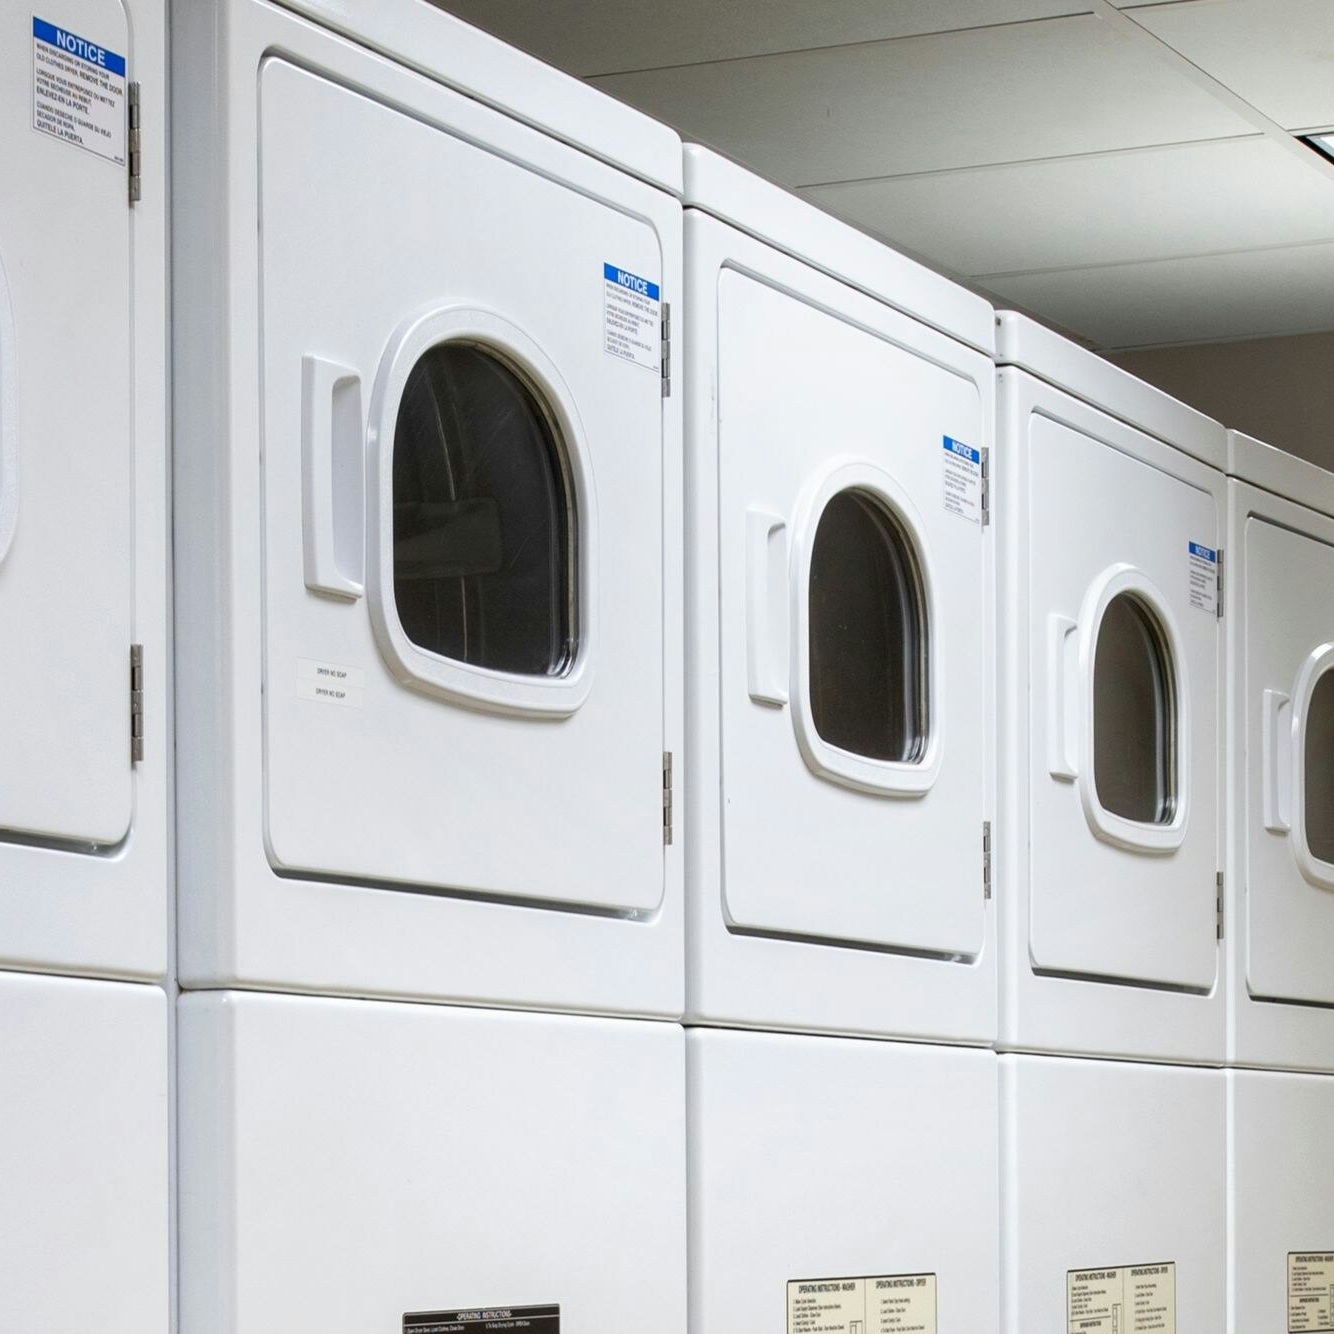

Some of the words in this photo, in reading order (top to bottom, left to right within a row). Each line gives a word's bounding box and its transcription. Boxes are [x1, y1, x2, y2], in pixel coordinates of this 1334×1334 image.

[57, 29, 105, 66] NOTICE
[617, 270, 648, 295] NOTICE
[952, 440, 972, 460] NOTICE
